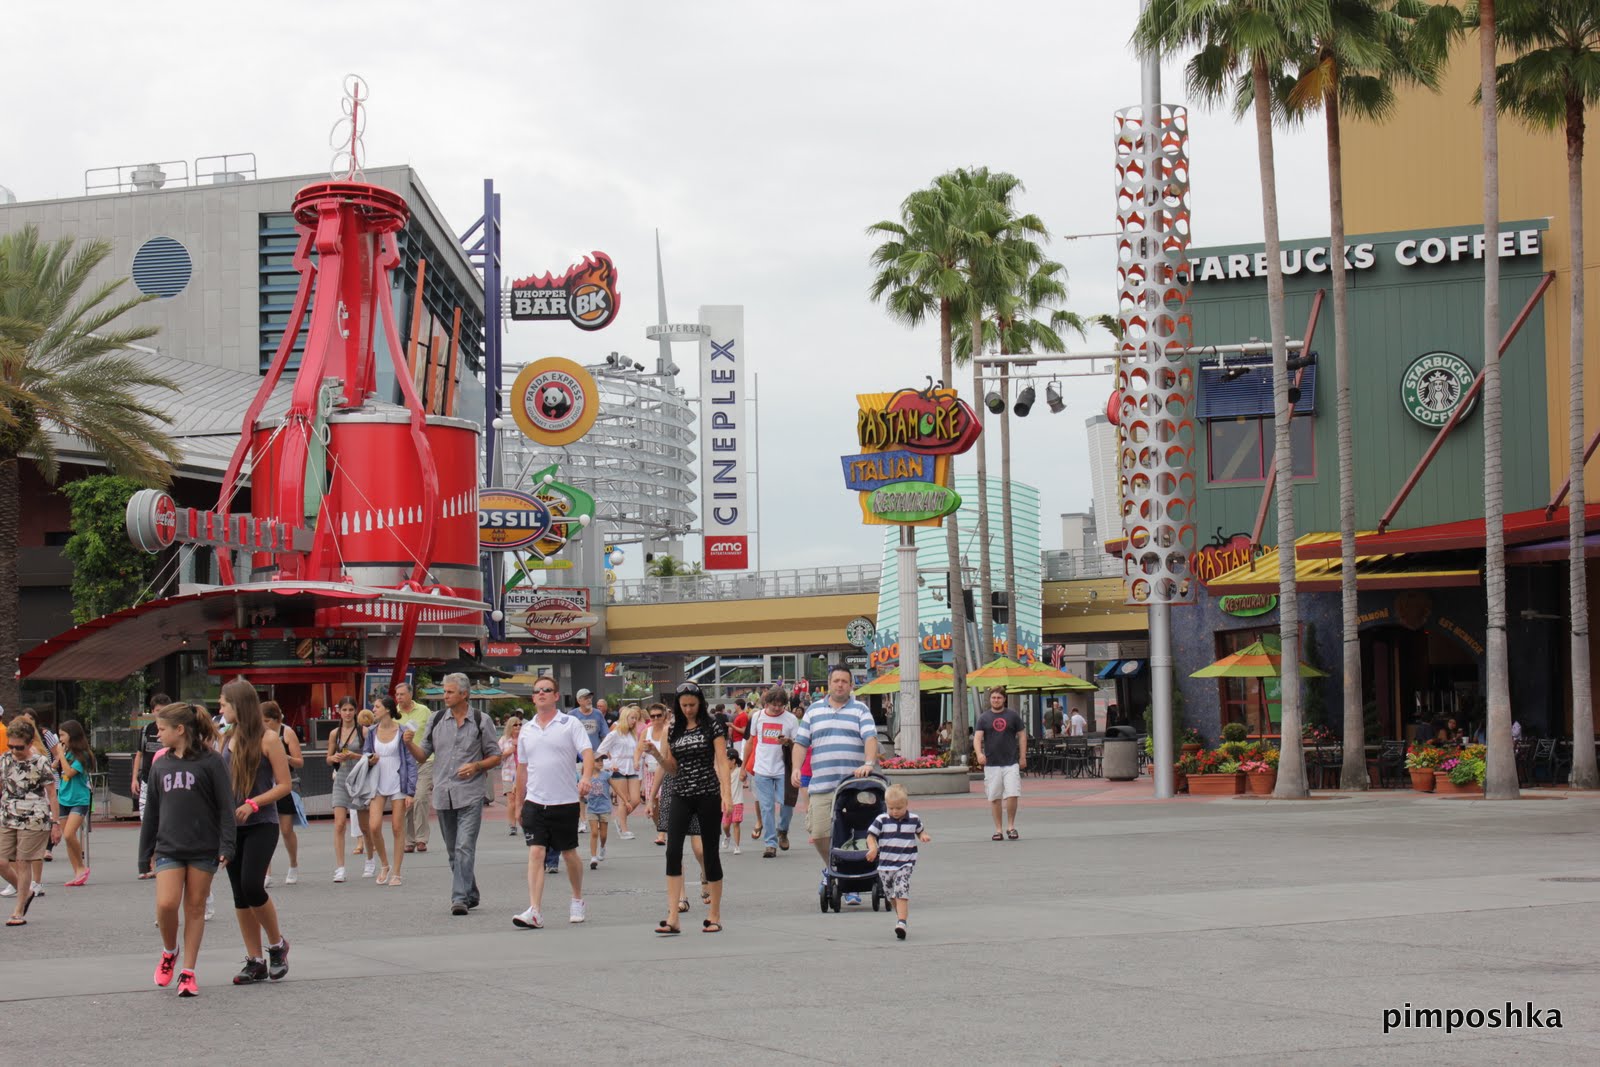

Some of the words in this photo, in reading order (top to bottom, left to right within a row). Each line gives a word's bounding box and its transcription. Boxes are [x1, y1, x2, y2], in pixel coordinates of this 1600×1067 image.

[1187, 244, 1375, 282] TARBUCKS
[1395, 229, 1540, 266] COFFEE
[514, 289, 567, 298] WHOPPER
[515, 299, 567, 315] BAR
[576, 289, 607, 316] BK
[652, 324, 705, 334] UNIVERSAL
[1406, 356, 1471, 389] STARBUCKS
[526, 375, 549, 402] PANDA
[551, 373, 583, 401] EXPRESS
[527, 406, 547, 427] GOURMET
[548, 420, 571, 429] CHINESE
[570, 406, 581, 420] FOOD
[711, 339, 737, 526] CINEPLEX
[850, 456, 923, 484] ITALIAN
[872, 489, 948, 514] RESTAURANT
[479, 511, 541, 527] OSSIL
[534, 600, 555, 610] SINCE
[557, 600, 574, 610] 1972
[1224, 594, 1272, 612] RESTAURANT
[551, 612, 583, 626] Flight
[847, 619, 872, 631] STARBUCKS
[533, 630, 553, 640] SURF
[555, 630, 574, 640] SHOP
[490, 647, 508, 655] Night
[869, 642, 899, 669] FOO
[922, 634, 953, 651] CLU
[674, 734, 705, 748] UESS?
[764, 729, 780, 737] LEGO
[163, 771, 196, 792] GAP
